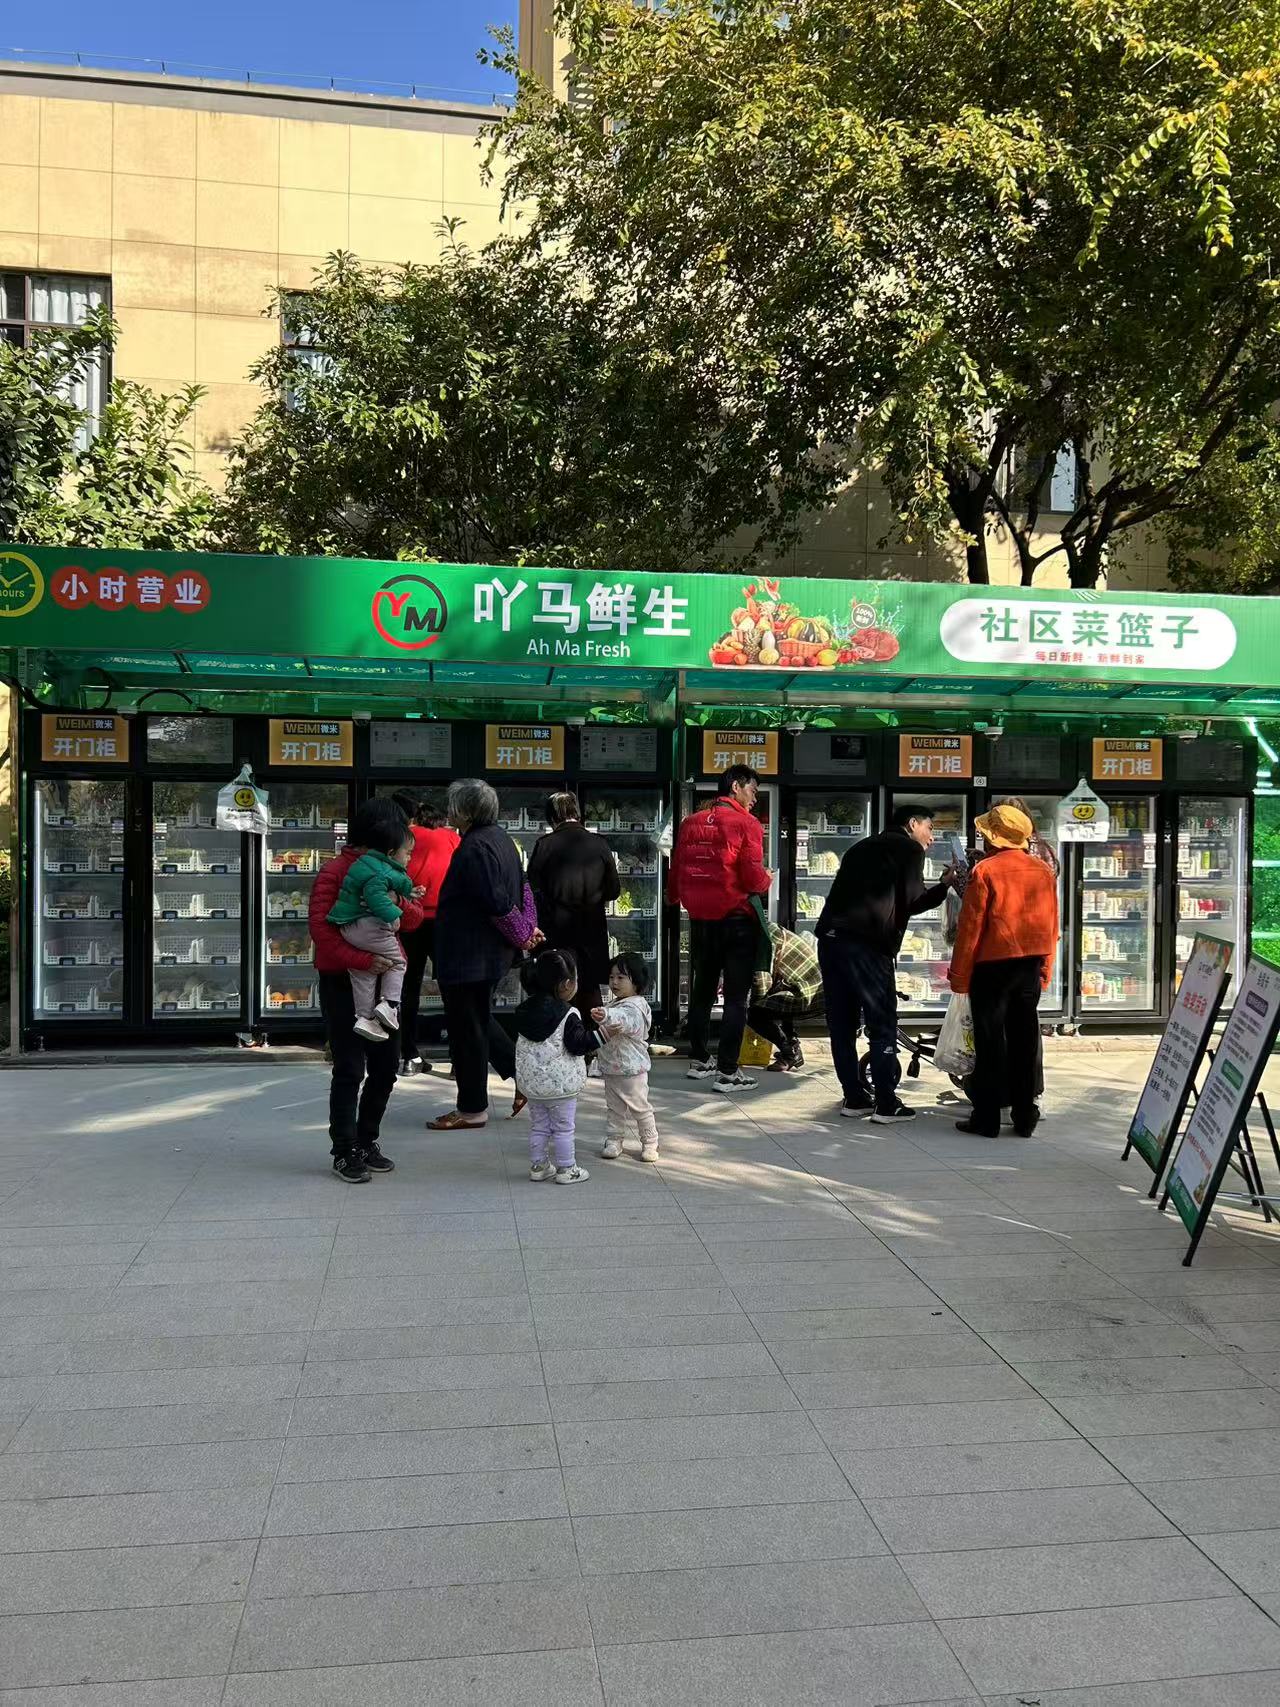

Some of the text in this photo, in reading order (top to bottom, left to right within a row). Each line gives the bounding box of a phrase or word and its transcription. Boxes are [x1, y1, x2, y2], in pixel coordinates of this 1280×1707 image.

[0, 589, 25, 598] ours
[61, 574, 201, 604] 小时营业
[473, 577, 691, 637] 吖马鲜生
[980, 607, 1199, 649] 社区菜篮子
[526, 638, 631, 658] Ah Ma Fresh
[53, 737, 117, 757] 开门柜
[281, 741, 342, 761] 开门柜
[496, 746, 553, 765] 开门柜
[713, 751, 768, 769] 开门柜
[908, 755, 962, 774] 开门柜
[1101, 757, 1153, 775] 开门柜
